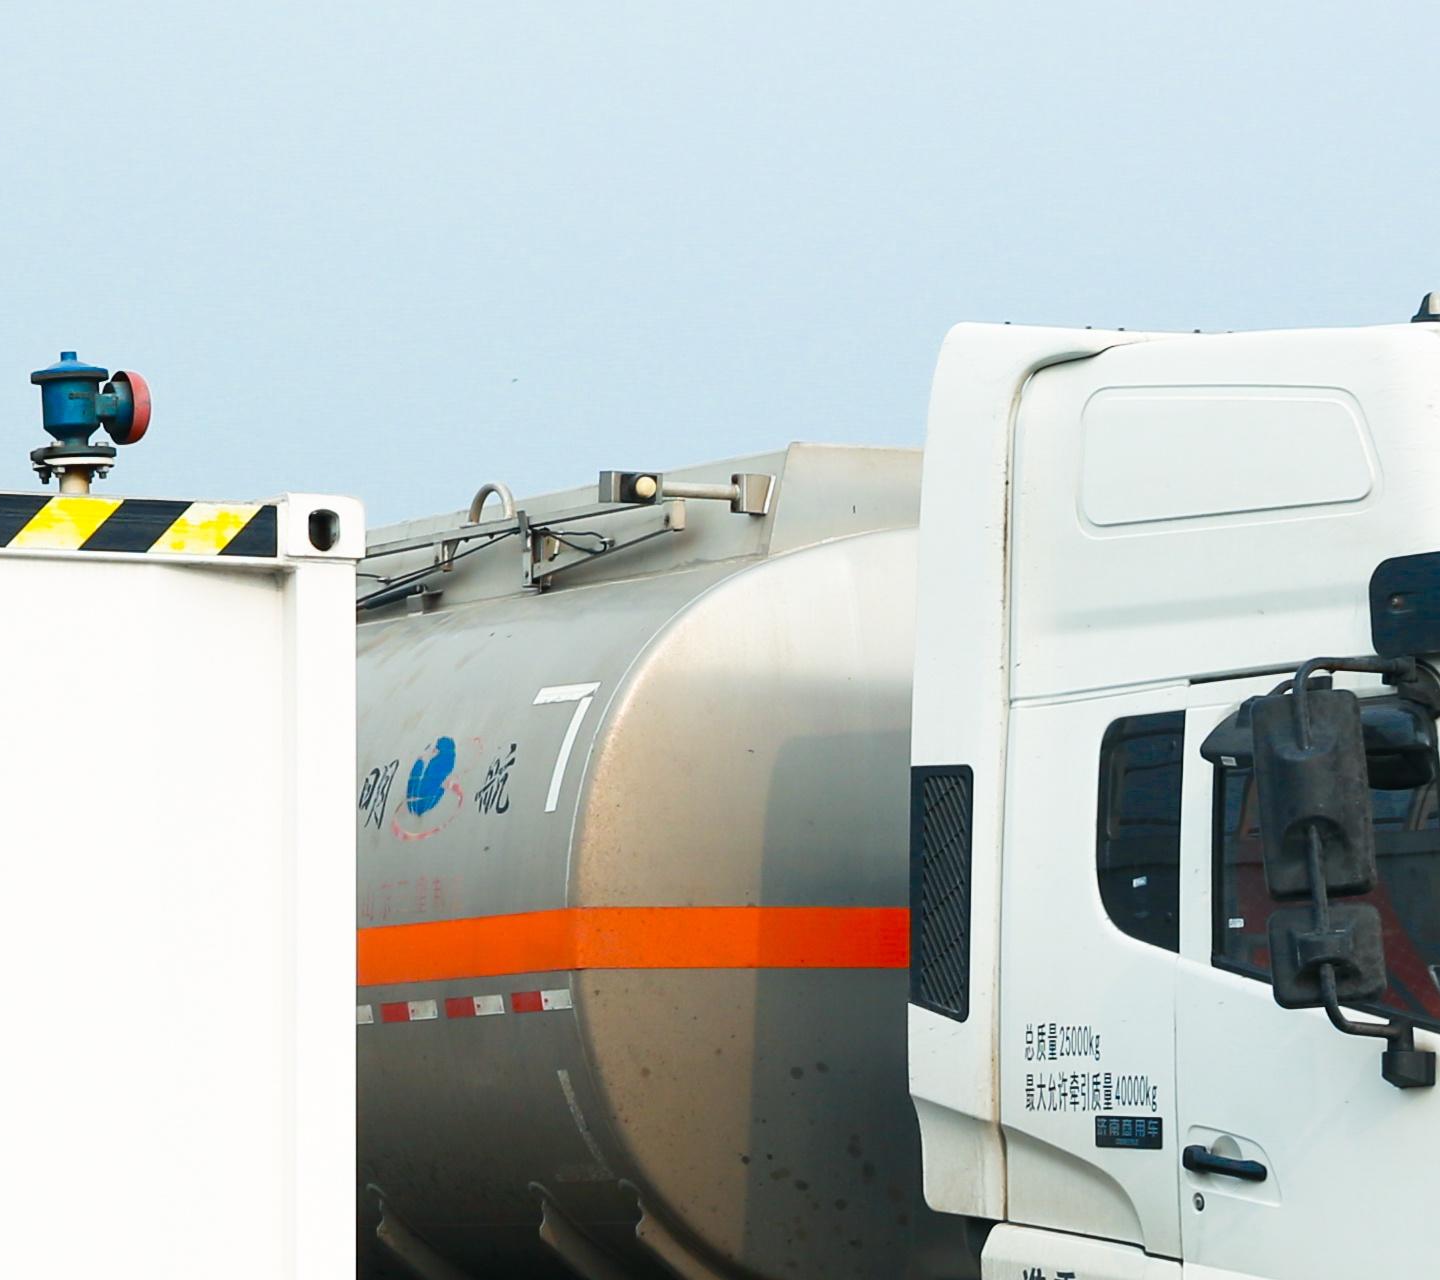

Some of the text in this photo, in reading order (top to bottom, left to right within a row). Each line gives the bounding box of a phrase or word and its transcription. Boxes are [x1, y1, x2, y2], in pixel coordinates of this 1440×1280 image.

[532, 681, 602, 813] 7
[1025, 1022, 1100, 1061] 总质量25000kg
[1025, 1071, 1158, 1112] 最大允许牵引质量40000kg
